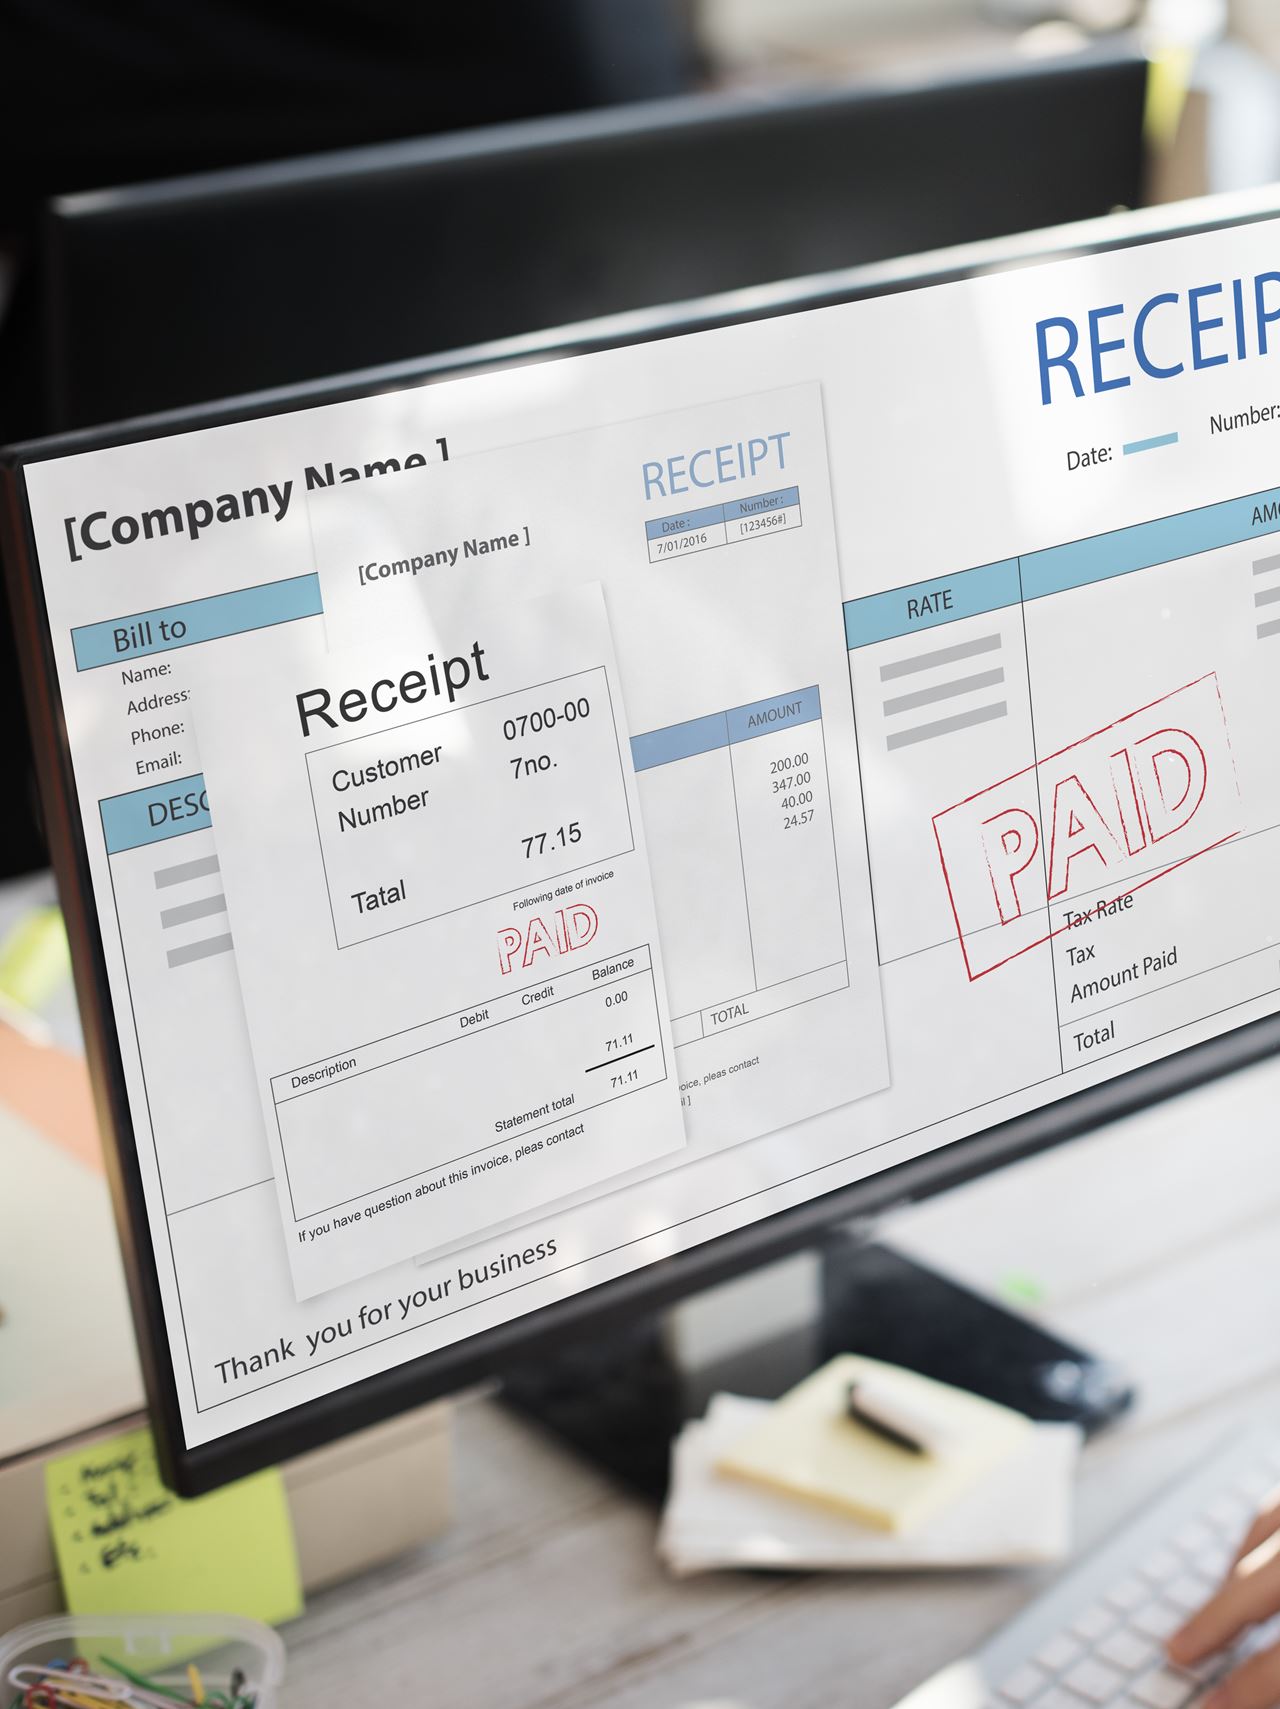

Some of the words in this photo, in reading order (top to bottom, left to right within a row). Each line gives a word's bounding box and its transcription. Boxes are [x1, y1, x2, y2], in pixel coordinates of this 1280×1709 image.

[1210, 402, 1280, 434] Number:
[642, 432, 791, 501] RECEIPT
[1067, 443, 1113, 471] Date:
[64, 480, 294, 563] [Company
[358, 546, 459, 586] [Company
[463, 532, 520, 560] Name
[657, 532, 708, 554] 7/01/2016
[907, 590, 954, 620] RATE
[113, 621, 153, 653] Bill
[160, 619, 187, 640] to
[121, 663, 172, 686] Name:
[296, 641, 490, 738] Receipt
[127, 689, 192, 715] Address:
[747, 701, 802, 729] AMOUNT
[131, 722, 185, 745] Phone:
[332, 745, 443, 793] Customer
[502, 696, 591, 741] 0700-00
[136, 751, 182, 775] Email:
[770, 752, 809, 775] 200.00
[337, 787, 430, 832] Number
[510, 752, 558, 780] 7no.
[772, 771, 811, 794] 347.00
[781, 790, 813, 810] 40.00
[784, 808, 815, 830] 24.57
[982, 729, 1206, 926] PAID
[522, 823, 582, 860] 77.15
[351, 879, 407, 915] Tatal
[513, 891, 553, 911] Following
[554, 884, 574, 897] date
[575, 880, 584, 890] of
[586, 870, 615, 887] invoice
[1063, 908, 1093, 931] Tax
[1097, 894, 1134, 920] Rate
[496, 904, 598, 975] PAID
[1066, 945, 1096, 967] Tax
[1071, 963, 1139, 1004] Amount
[1142, 945, 1178, 976] Paid
[605, 991, 629, 1008] 0.00
[710, 1003, 749, 1026] TOTAL
[291, 1056, 357, 1089] Description
[460, 1010, 490, 1028] Debit
[521, 986, 555, 1006] Credit
[592, 957, 635, 980] Balance
[1073, 1020, 1116, 1052] Total
[605, 1033, 634, 1052] 71.11
[703, 1068, 727, 1085] pleas
[728, 1056, 760, 1074] contact
[494, 1102, 550, 1133] Statement
[551, 1094, 575, 1115] total
[610, 1070, 639, 1089] 71.11
[298, 1231, 306, 1242] If
[308, 1223, 331, 1241] you
[333, 1211, 362, 1230] have
[364, 1191, 412, 1219] question
[415, 1178, 447, 1198] about
[448, 1169, 469, 1185] this
[471, 1153, 513, 1176] invoice,
[515, 1140, 544, 1160] pleas
[546, 1123, 585, 1146] contact
[214, 1338, 296, 1384] Thank
[306, 1319, 353, 1357] you
[358, 1302, 393, 1329] for
[398, 1279, 452, 1320] your
[458, 1239, 558, 1291] business
